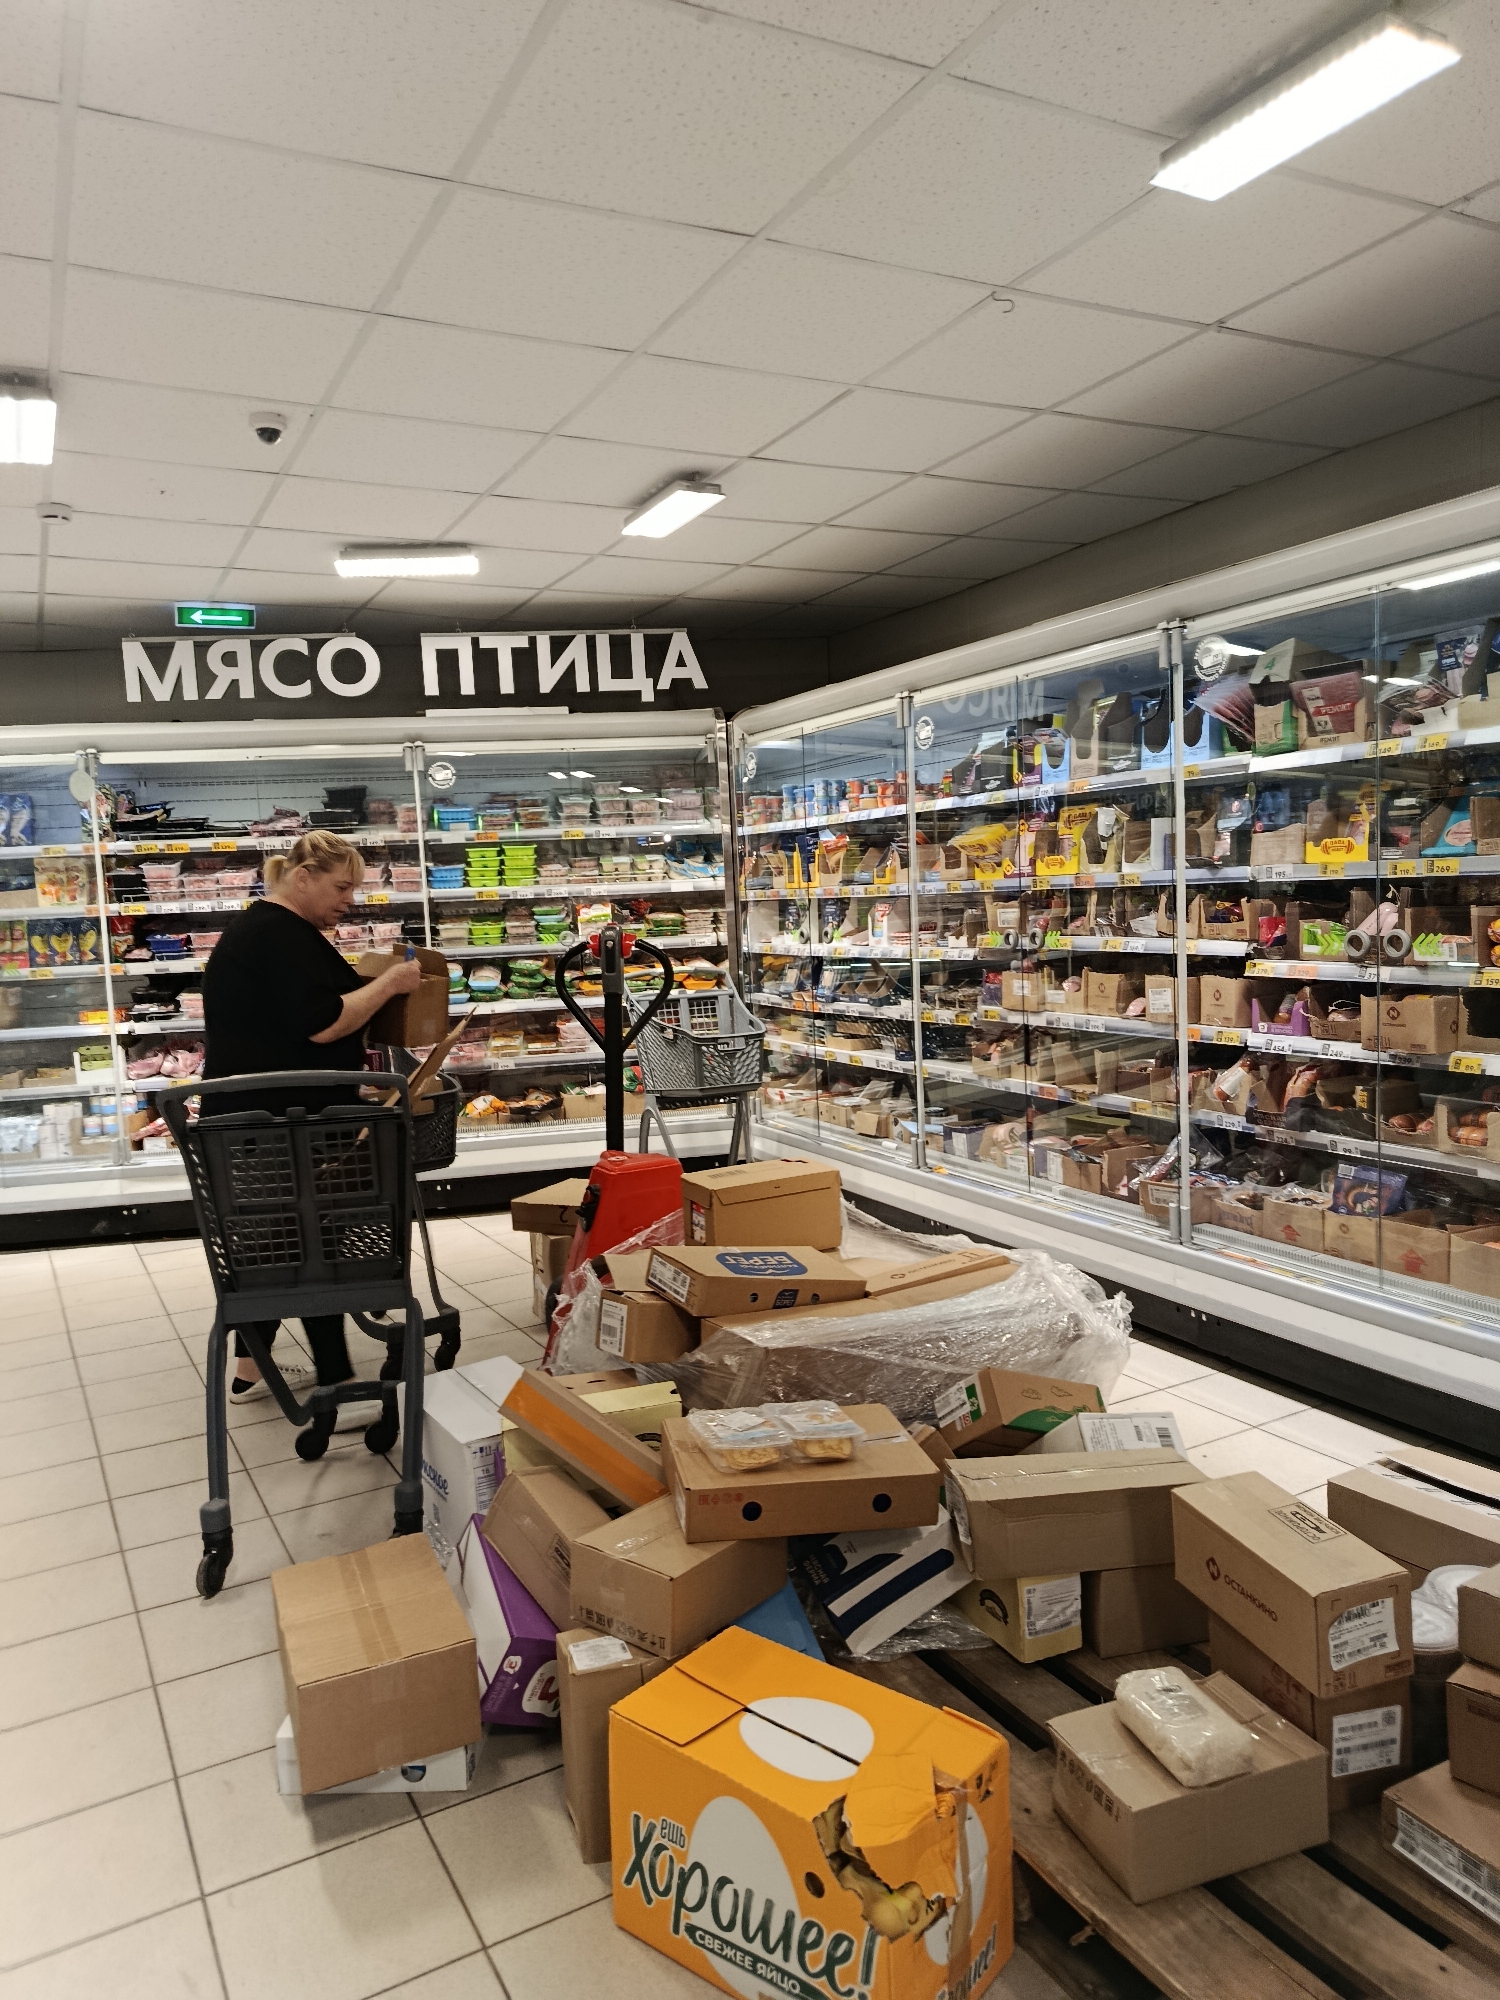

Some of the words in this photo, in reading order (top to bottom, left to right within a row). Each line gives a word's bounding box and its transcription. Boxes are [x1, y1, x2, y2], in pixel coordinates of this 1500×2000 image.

[122, 637, 382, 702] МЯСО
[420, 631, 709, 702] ПТИЦА
[1224, 1574, 1278, 1622] ОСТАНКИНО
[660, 1818, 686, 1849] ешь
[623, 1813, 879, 2000] Хорошее!
[695, 1931, 755, 1972] СВЕЖЕЕ
[756, 1963, 801, 1995] ЯЙЦО
